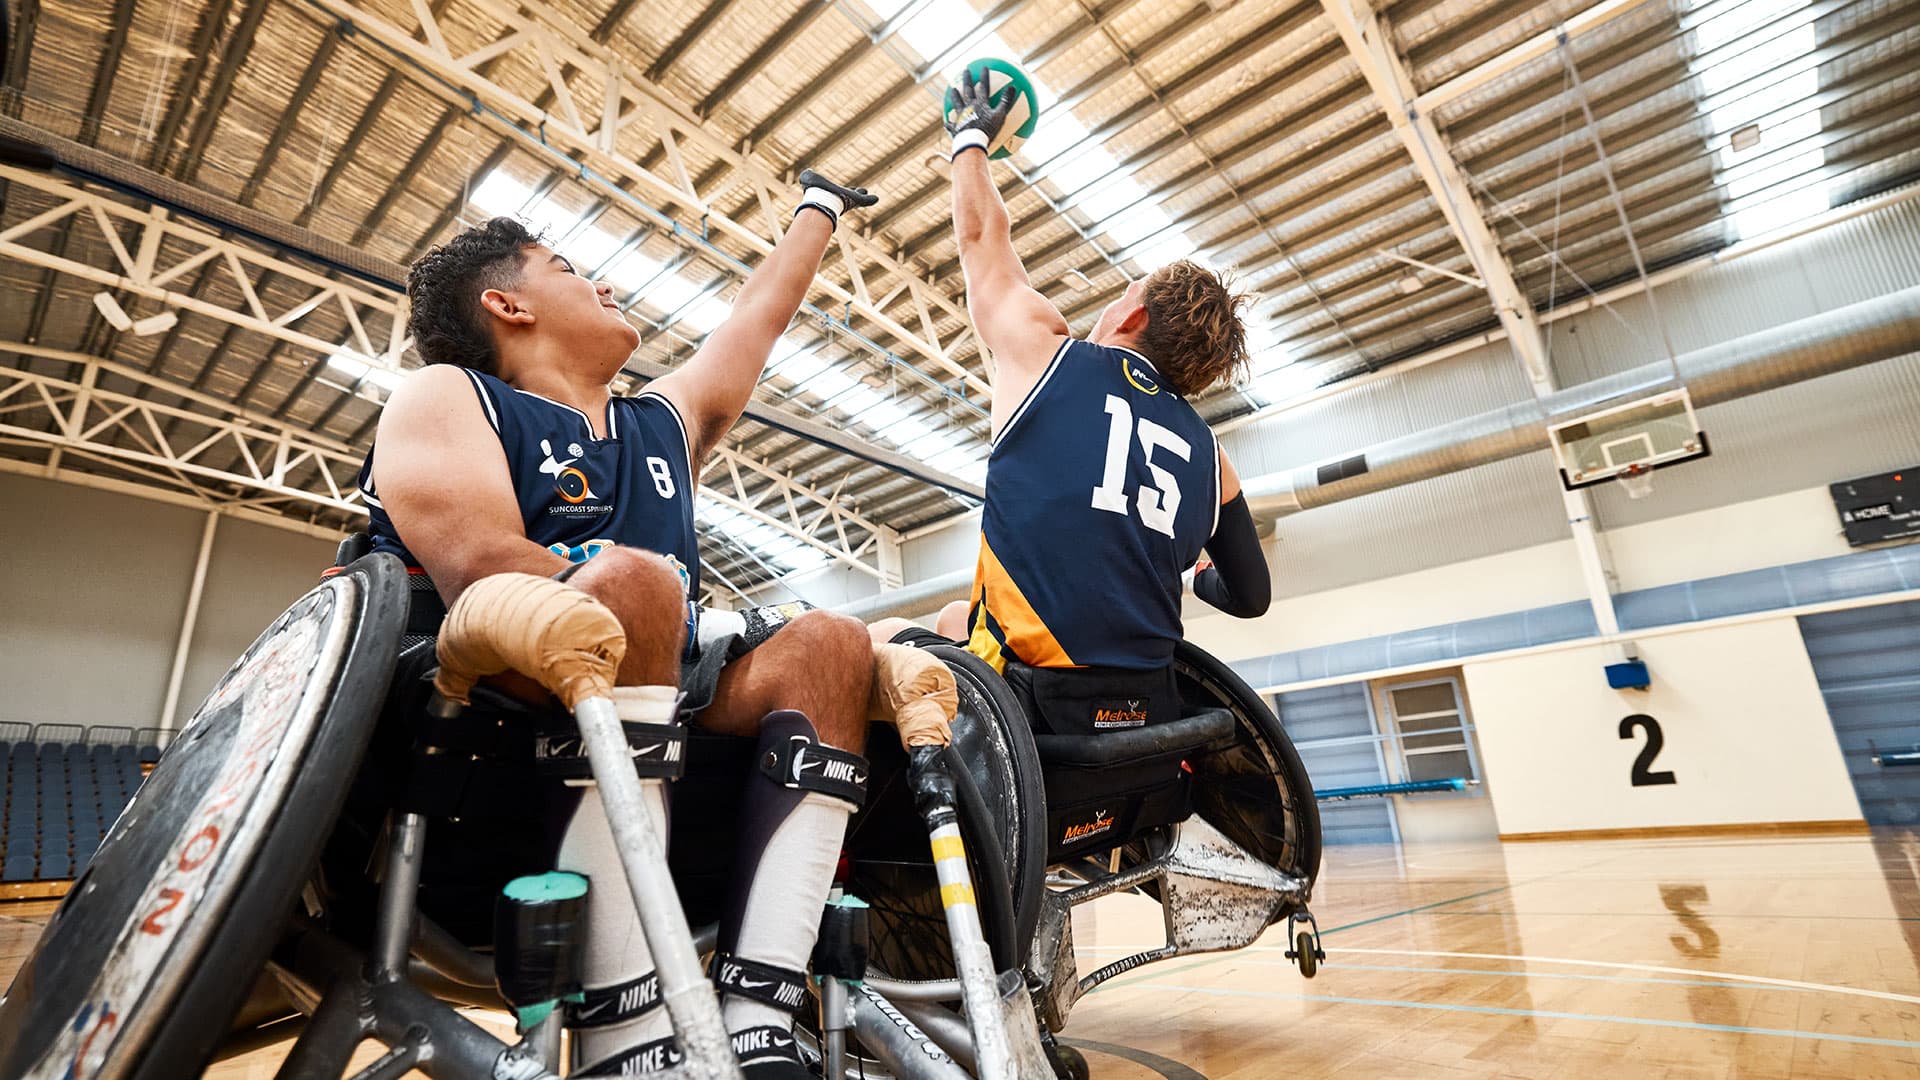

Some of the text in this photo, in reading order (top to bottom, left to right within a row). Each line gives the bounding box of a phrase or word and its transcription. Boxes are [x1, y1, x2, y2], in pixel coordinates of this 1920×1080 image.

[646, 457, 676, 499] 8
[1091, 394, 1192, 539] 15
[549, 505, 586, 514] SUNCOAST
[1855, 505, 1889, 518] HOME
[1096, 709, 1146, 723] Melrose
[1618, 714, 1677, 787] 2
[823, 759, 855, 782] NIKE
[1064, 817, 1114, 838] Melrose
[720, 962, 742, 985] KE
[617, 976, 658, 1015] NIKE
[731, 1029, 770, 1055] NIKE
[621, 1045, 665, 1076] NIKE
